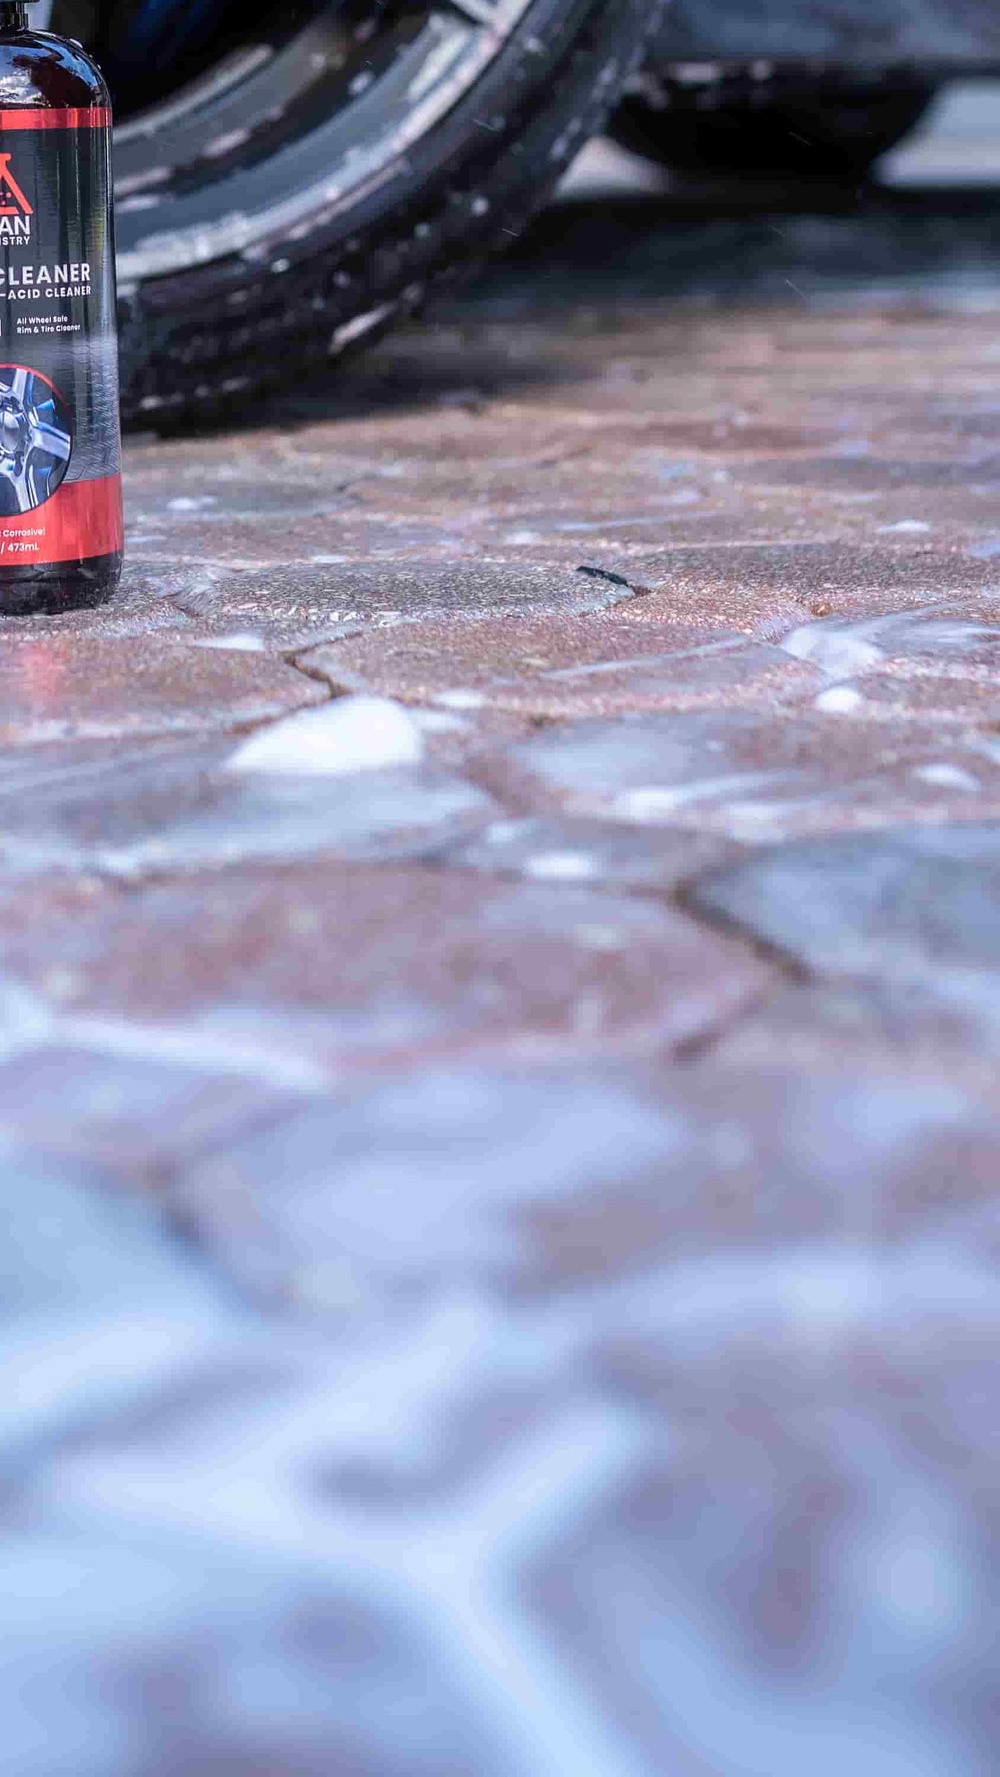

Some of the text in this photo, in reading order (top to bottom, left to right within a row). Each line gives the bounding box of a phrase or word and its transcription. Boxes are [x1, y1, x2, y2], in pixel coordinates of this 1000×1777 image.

[45, 285, 92, 298] CLEANER
[16, 315, 68, 325] All Wheel Safe
[16, 326, 32, 334] Rim
[40, 325, 55, 333] Tire
[55, 324, 81, 332] Cleaner
[2, 527, 46, 537] Corrosive!
[0, 541, 5, 555] /
[7, 542, 40, 552] 473mL
